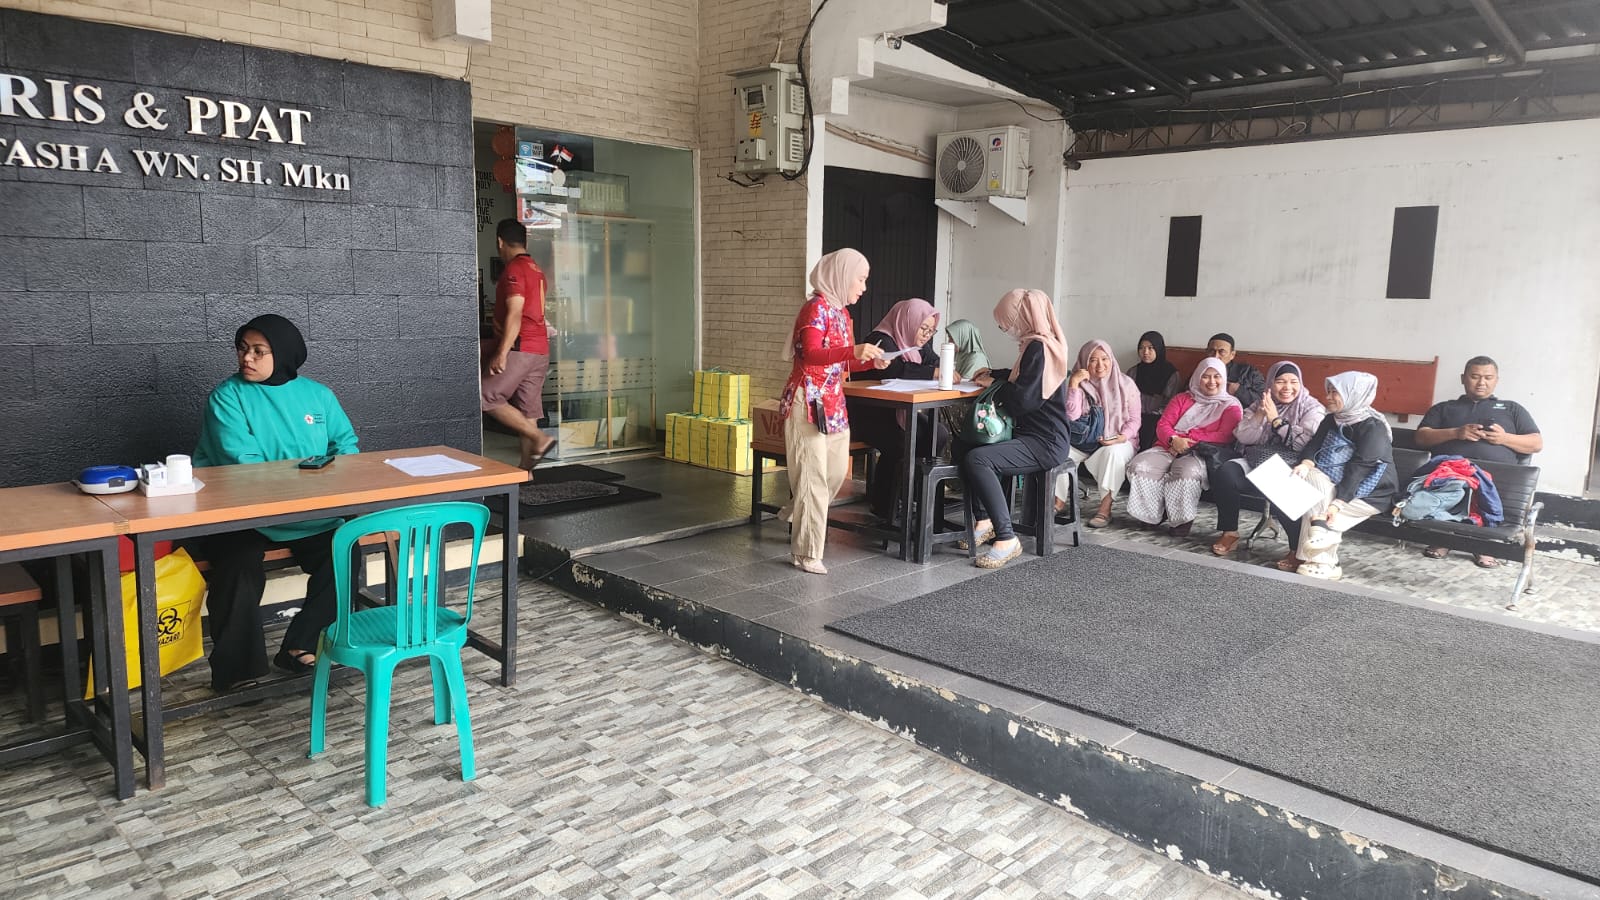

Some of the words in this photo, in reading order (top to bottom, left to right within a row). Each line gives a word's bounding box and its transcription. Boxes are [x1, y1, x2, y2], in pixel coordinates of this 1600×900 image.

[0, 73, 106, 125] RIS
[124, 92, 168, 131] &
[185, 96, 311, 146] PPAT
[132, 150, 210, 181] WN.
[220, 158, 272, 185] SH.
[281, 162, 350, 191] Mkn
